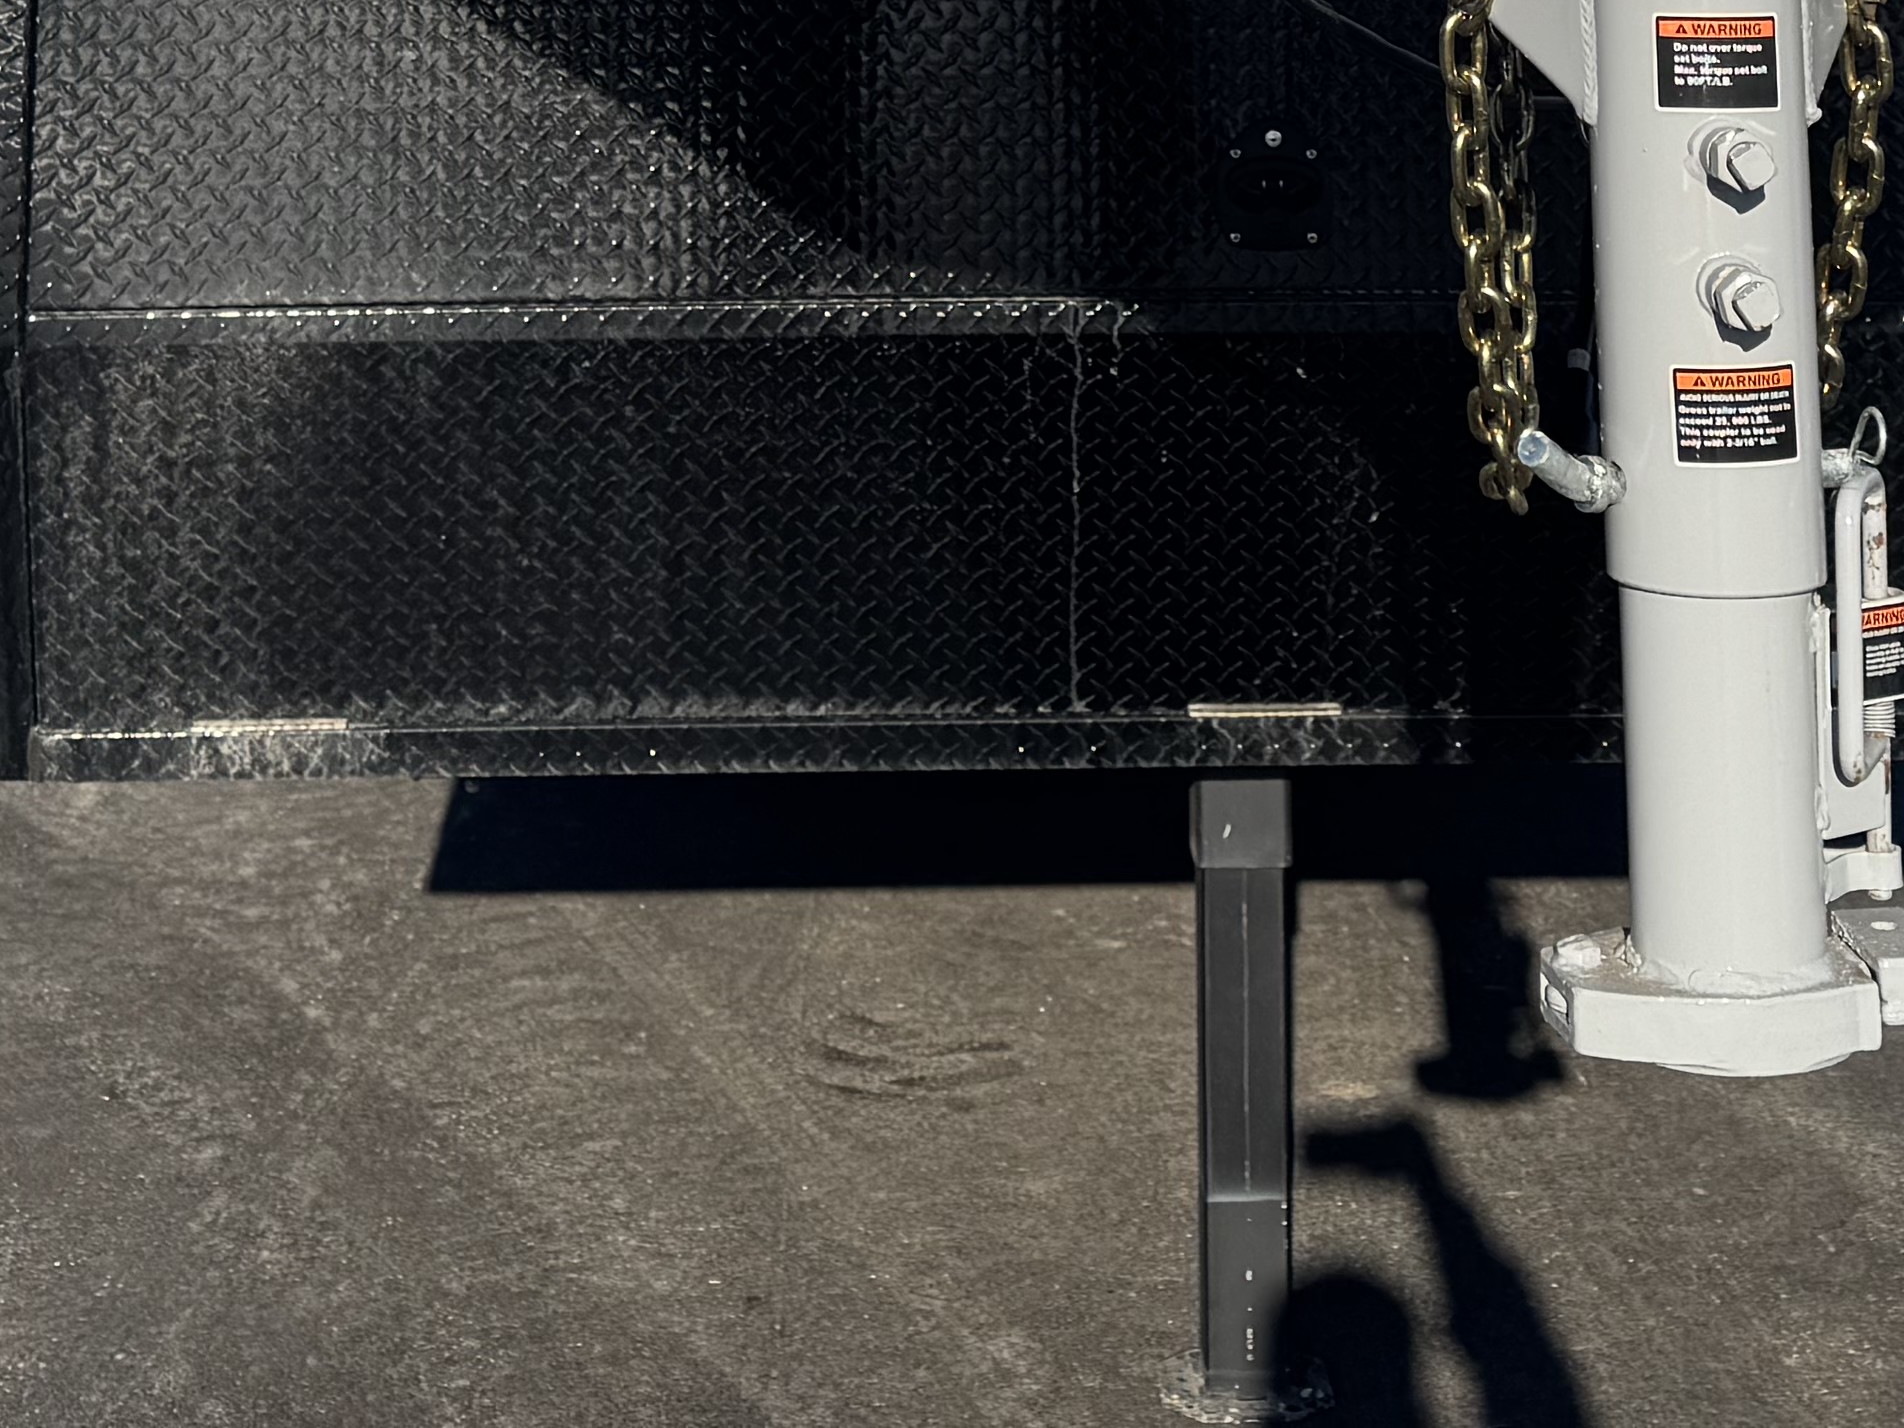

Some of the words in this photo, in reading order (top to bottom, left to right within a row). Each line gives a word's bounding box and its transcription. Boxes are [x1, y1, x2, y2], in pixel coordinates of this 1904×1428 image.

[1691, 23, 1762, 36] WARNING
[1673, 42, 1688, 52] Do
[1690, 43, 1708, 52] not
[1732, 44, 1763, 53] torque
[1709, 373, 1781, 387] WARNING
[1678, 405, 1707, 415] Gross
[1708, 406, 1737, 415] trailer
[1738, 404, 1768, 415] weight
[1679, 417, 1713, 426] exceed
[1679, 426, 1701, 436] This
[1702, 427, 1739, 438] coupler
[1741, 427, 1751, 436] to
[1753, 427, 1764, 435] be
[1766, 424, 1786, 434] used
[1680, 439, 1702, 449] only
[1703, 438, 1724, 447] with
